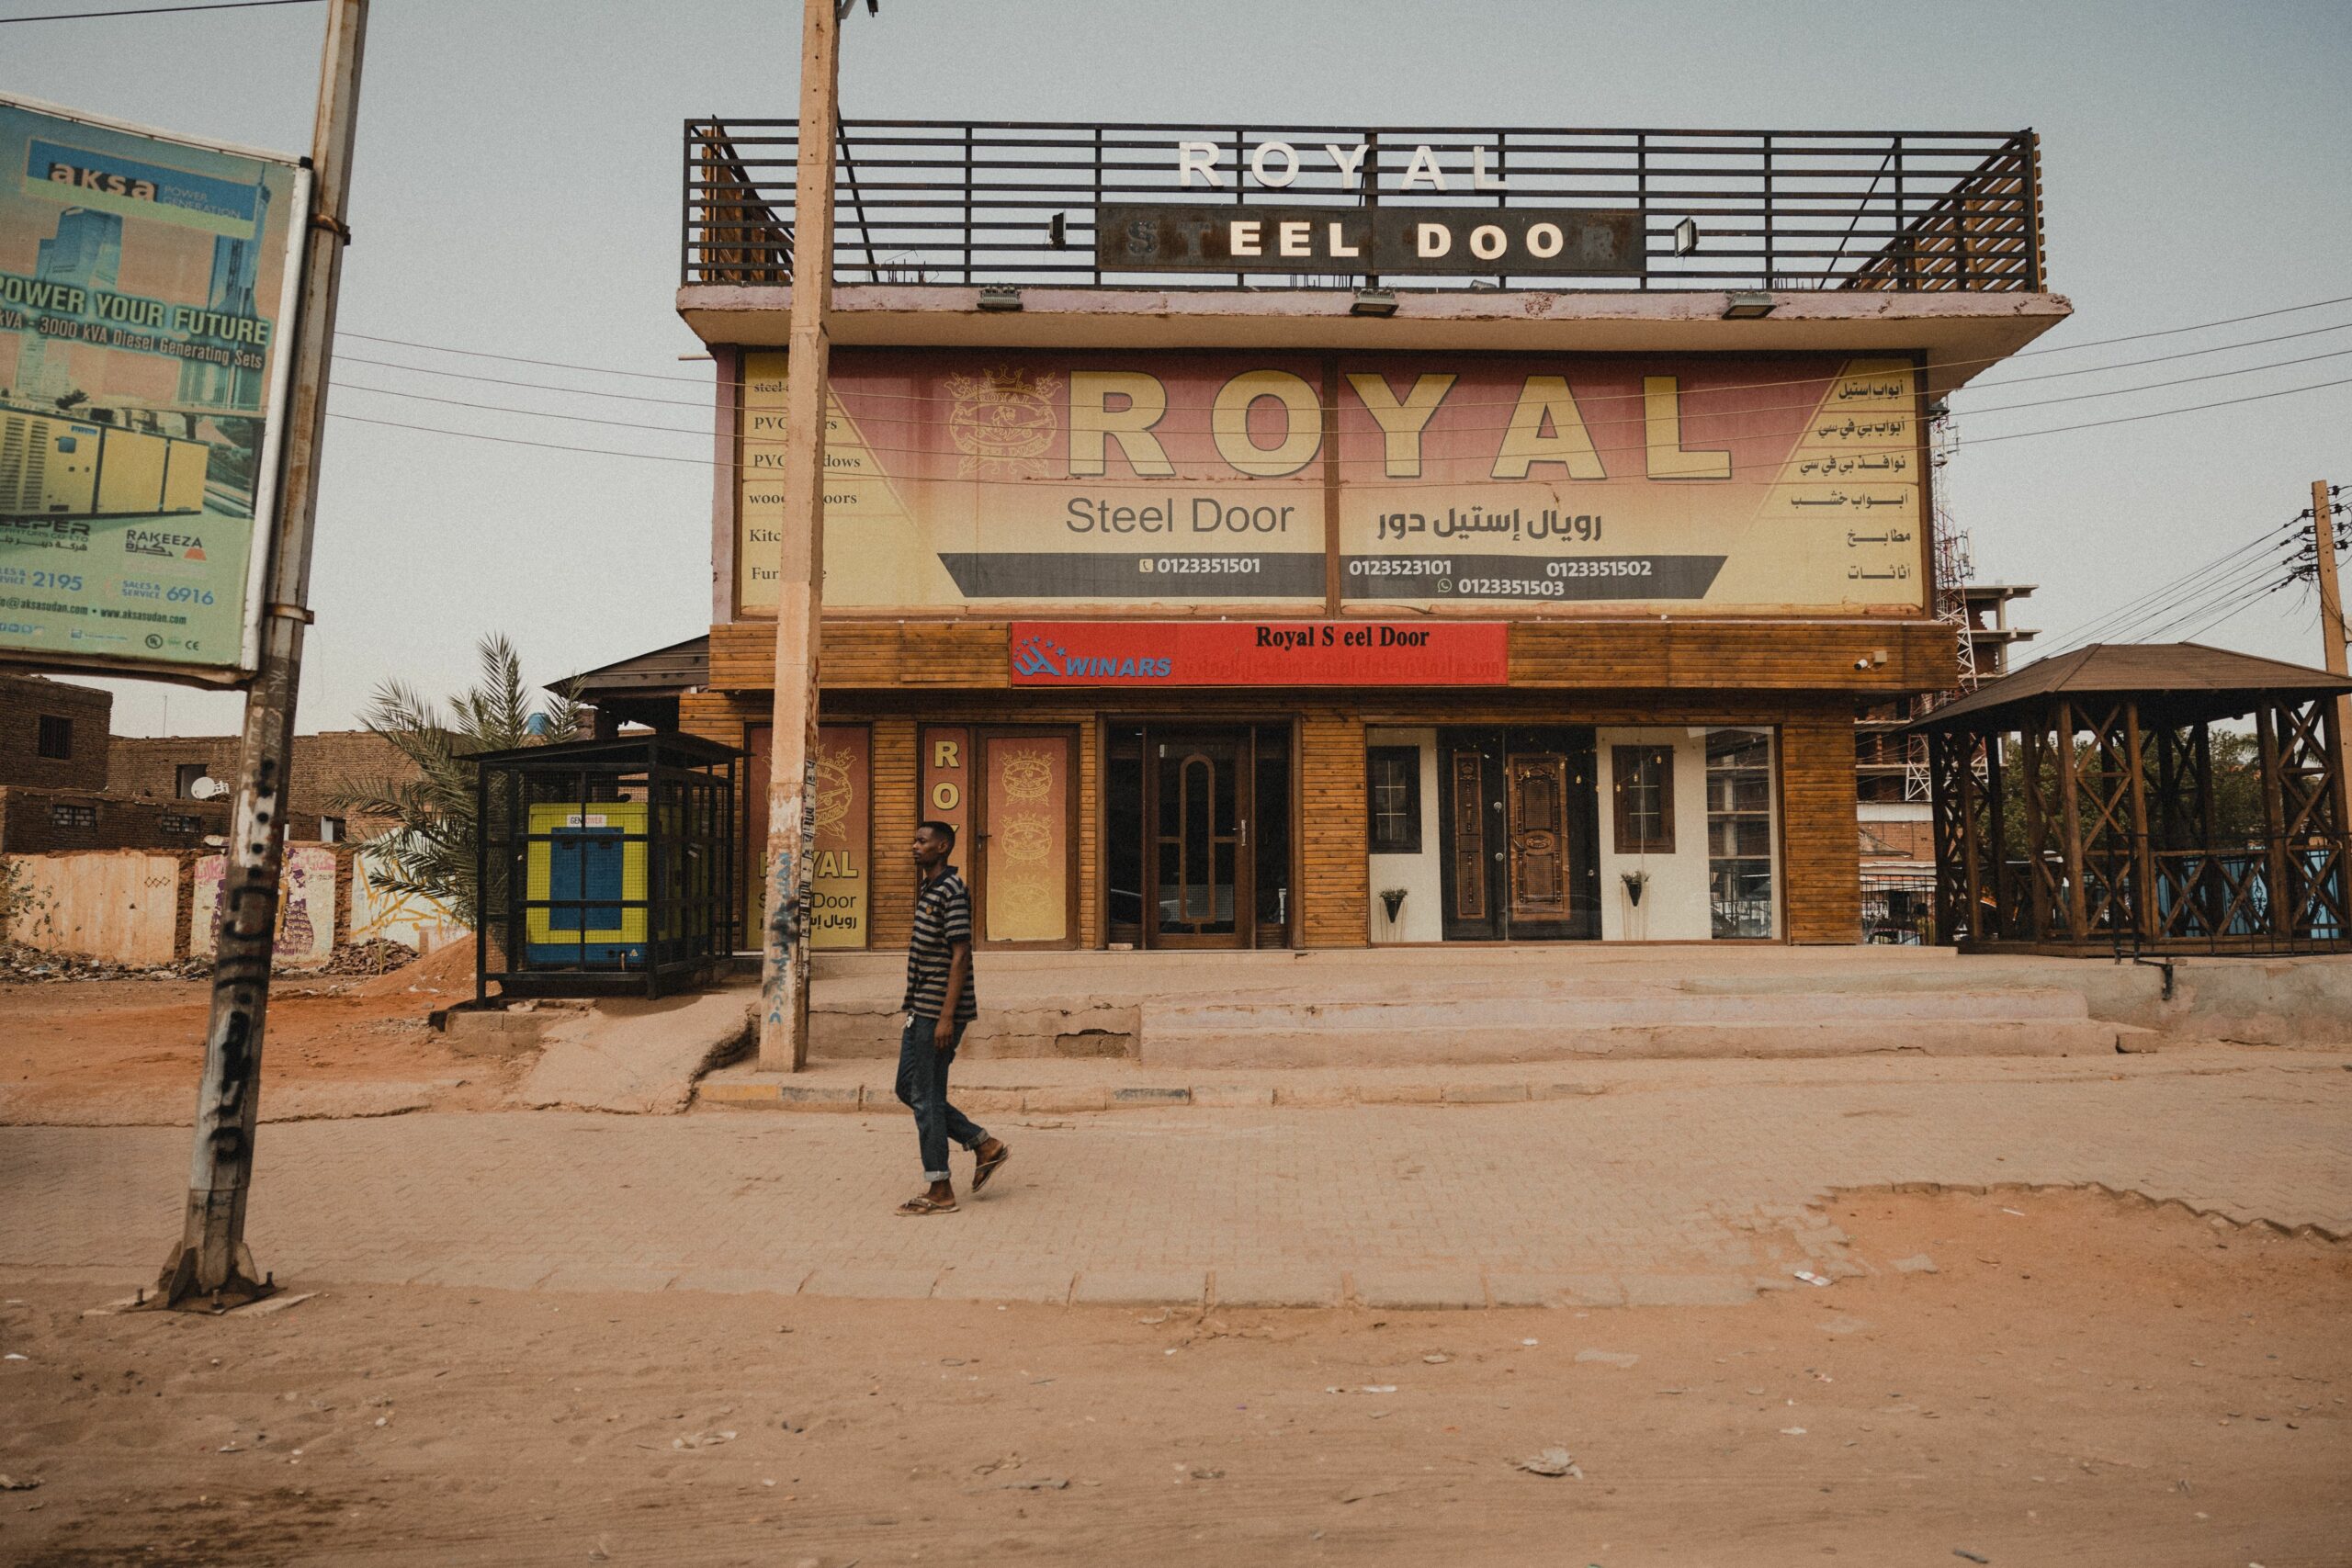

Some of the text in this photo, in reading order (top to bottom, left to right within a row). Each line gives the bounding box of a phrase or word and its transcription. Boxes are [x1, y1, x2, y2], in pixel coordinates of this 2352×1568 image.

[1179, 141, 1508, 191] ROYAL
[51, 164, 154, 202] aksa
[164, 186, 207, 201] POWER
[164, 197, 241, 219] GENERATION
[96, 293, 164, 328] YOUR
[173, 308, 269, 346] FUTURE
[40, 317, 78, 338] 3000
[83, 323, 108, 344] kVA
[113, 329, 154, 352] Diesel
[160, 337, 231, 367] Generating
[234, 349, 263, 369] Sets
[754, 381, 782, 392] steel
[1069, 369, 1732, 480] ROYAL
[823, 454, 861, 468] dows
[749, 493, 857, 504] woo oors
[1067, 497, 1295, 533] Steel Door
[1377, 505, 1602, 542] رويال إستيل دور
[126, 529, 203, 548] RAKEEZA
[749, 529, 781, 542] Kitc
[1157, 558, 1261, 574] 0123351501
[1349, 560, 1652, 577] 0123523101 0123351502
[33, 570, 83, 592] 2195
[122, 580, 151, 590] SALES
[1458, 579, 1565, 596] 0123351503
[122, 589, 160, 599] SERVICE
[166, 586, 214, 605] 6916
[100, 607, 187, 625] www.aksasudan.com
[1256, 626, 1315, 651] Royal
[1379, 626, 1430, 647] Door
[1065, 657, 1172, 677] WINARS
[811, 892, 857, 908] Door
[823, 913, 857, 930] رويال
